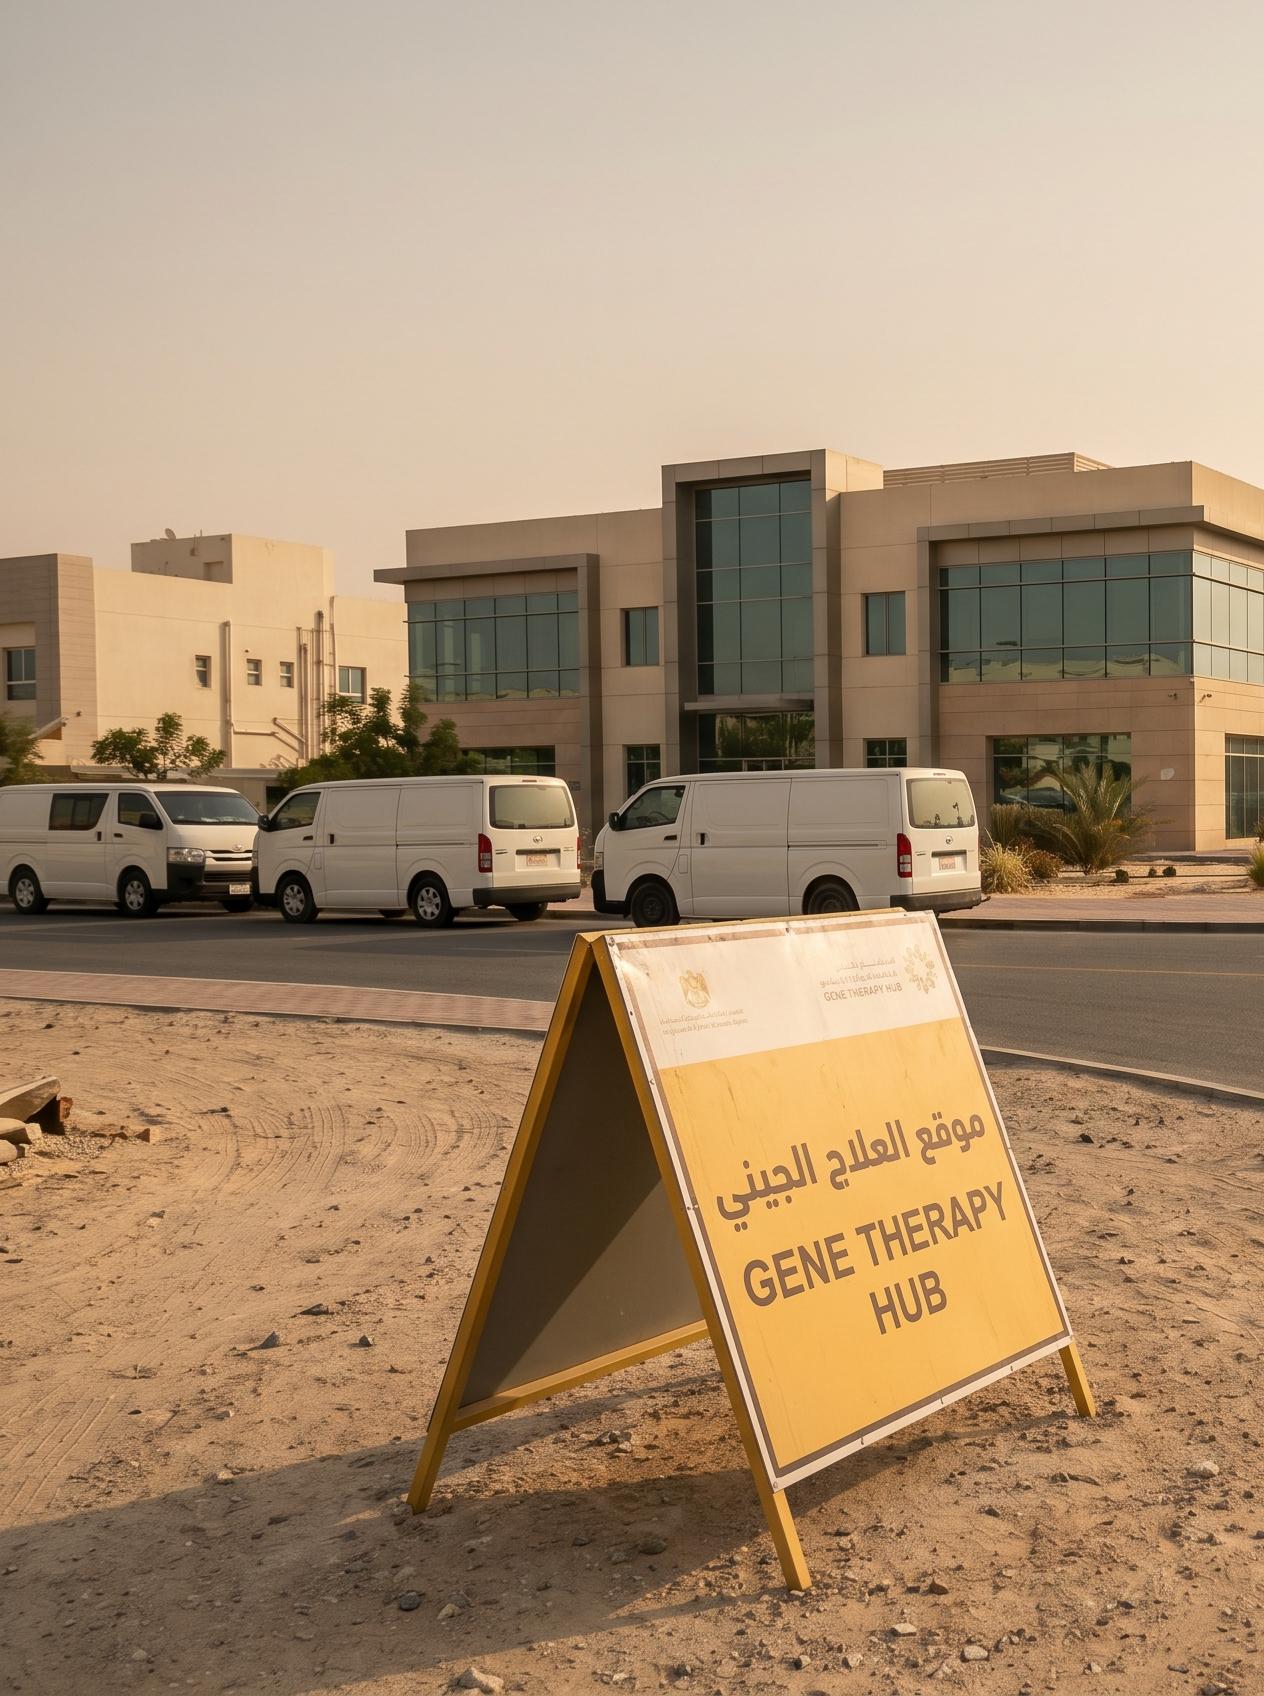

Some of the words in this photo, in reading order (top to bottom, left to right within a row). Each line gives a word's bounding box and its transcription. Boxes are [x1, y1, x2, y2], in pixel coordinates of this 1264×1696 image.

[848, 985, 884, 999] THERAPY
[885, 982, 903, 993] HUB
[826, 1119, 910, 1191] العلاج
[915, 1111, 985, 1166] موقع
[716, 1142, 818, 1233] الجيني
[743, 1232, 856, 1307] GENE
[855, 1181, 1006, 1267] THERAPY
[869, 1270, 948, 1335] HUB
